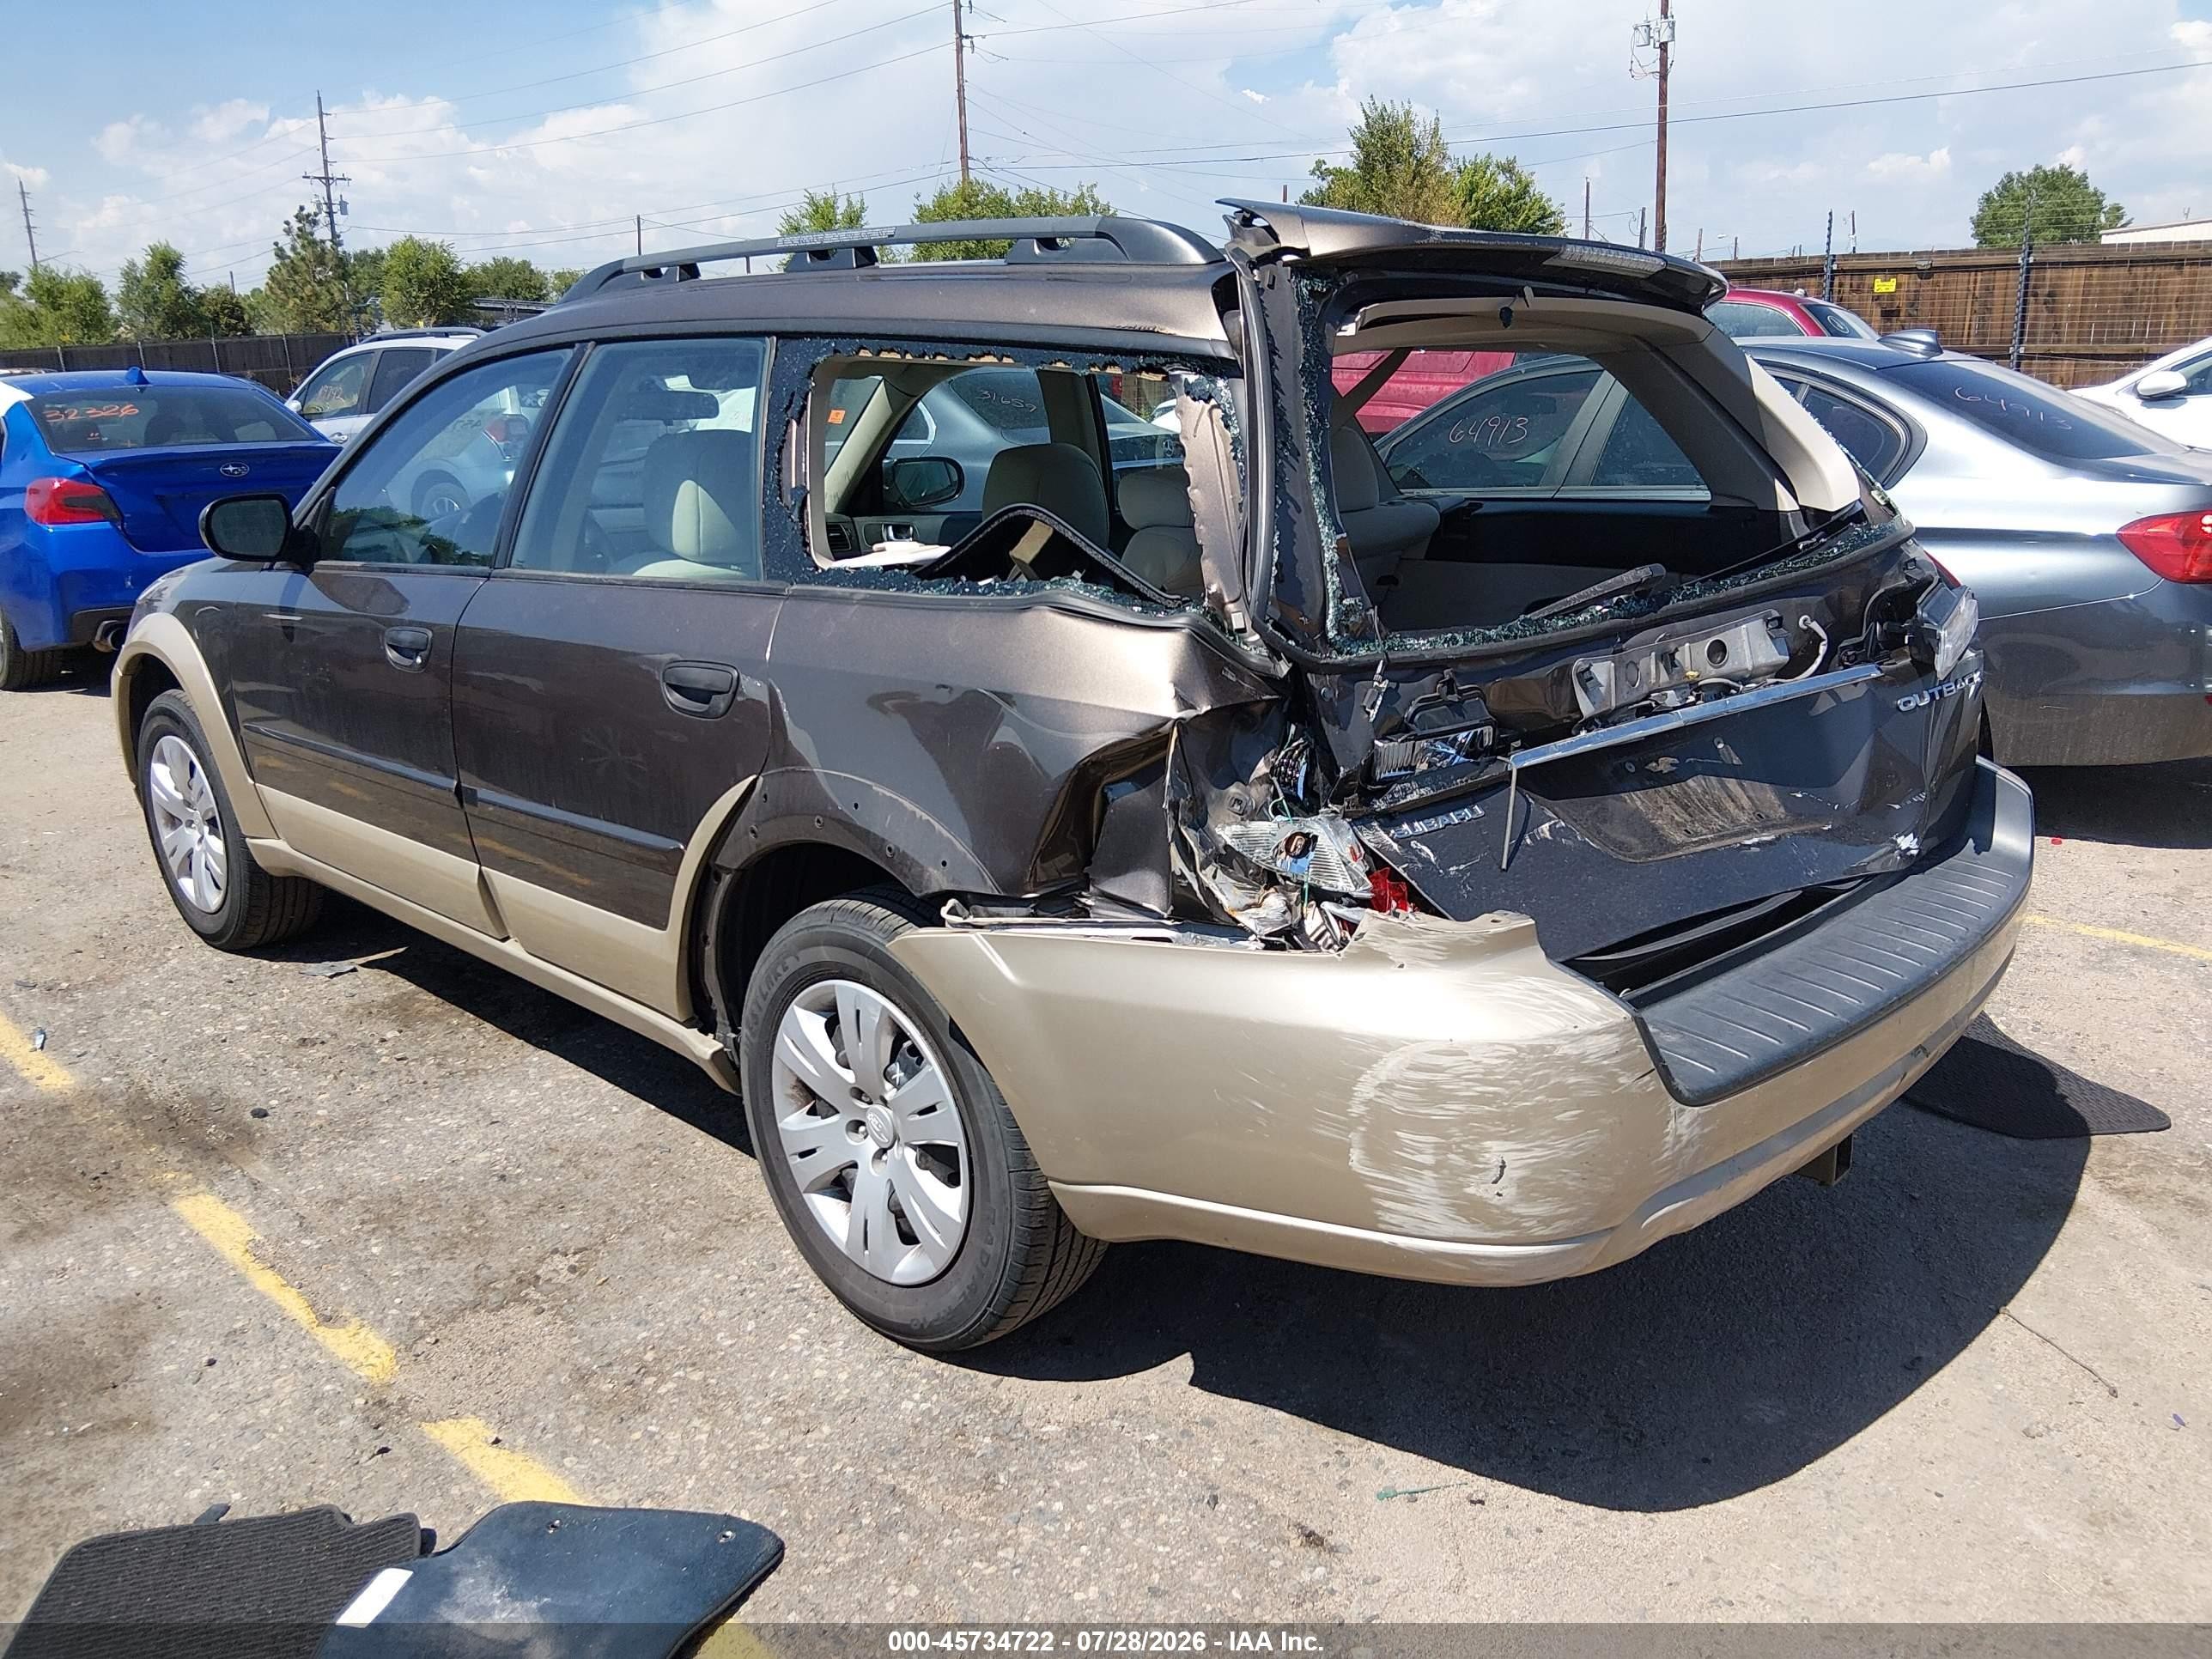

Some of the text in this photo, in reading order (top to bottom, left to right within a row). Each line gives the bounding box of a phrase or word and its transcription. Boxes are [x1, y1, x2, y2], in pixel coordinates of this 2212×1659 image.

[44, 404, 139, 422] 32326
[1449, 416, 1528, 447] 64913
[1897, 671, 1983, 712] OUTBACK
[1390, 805, 1486, 839] SUBARU
